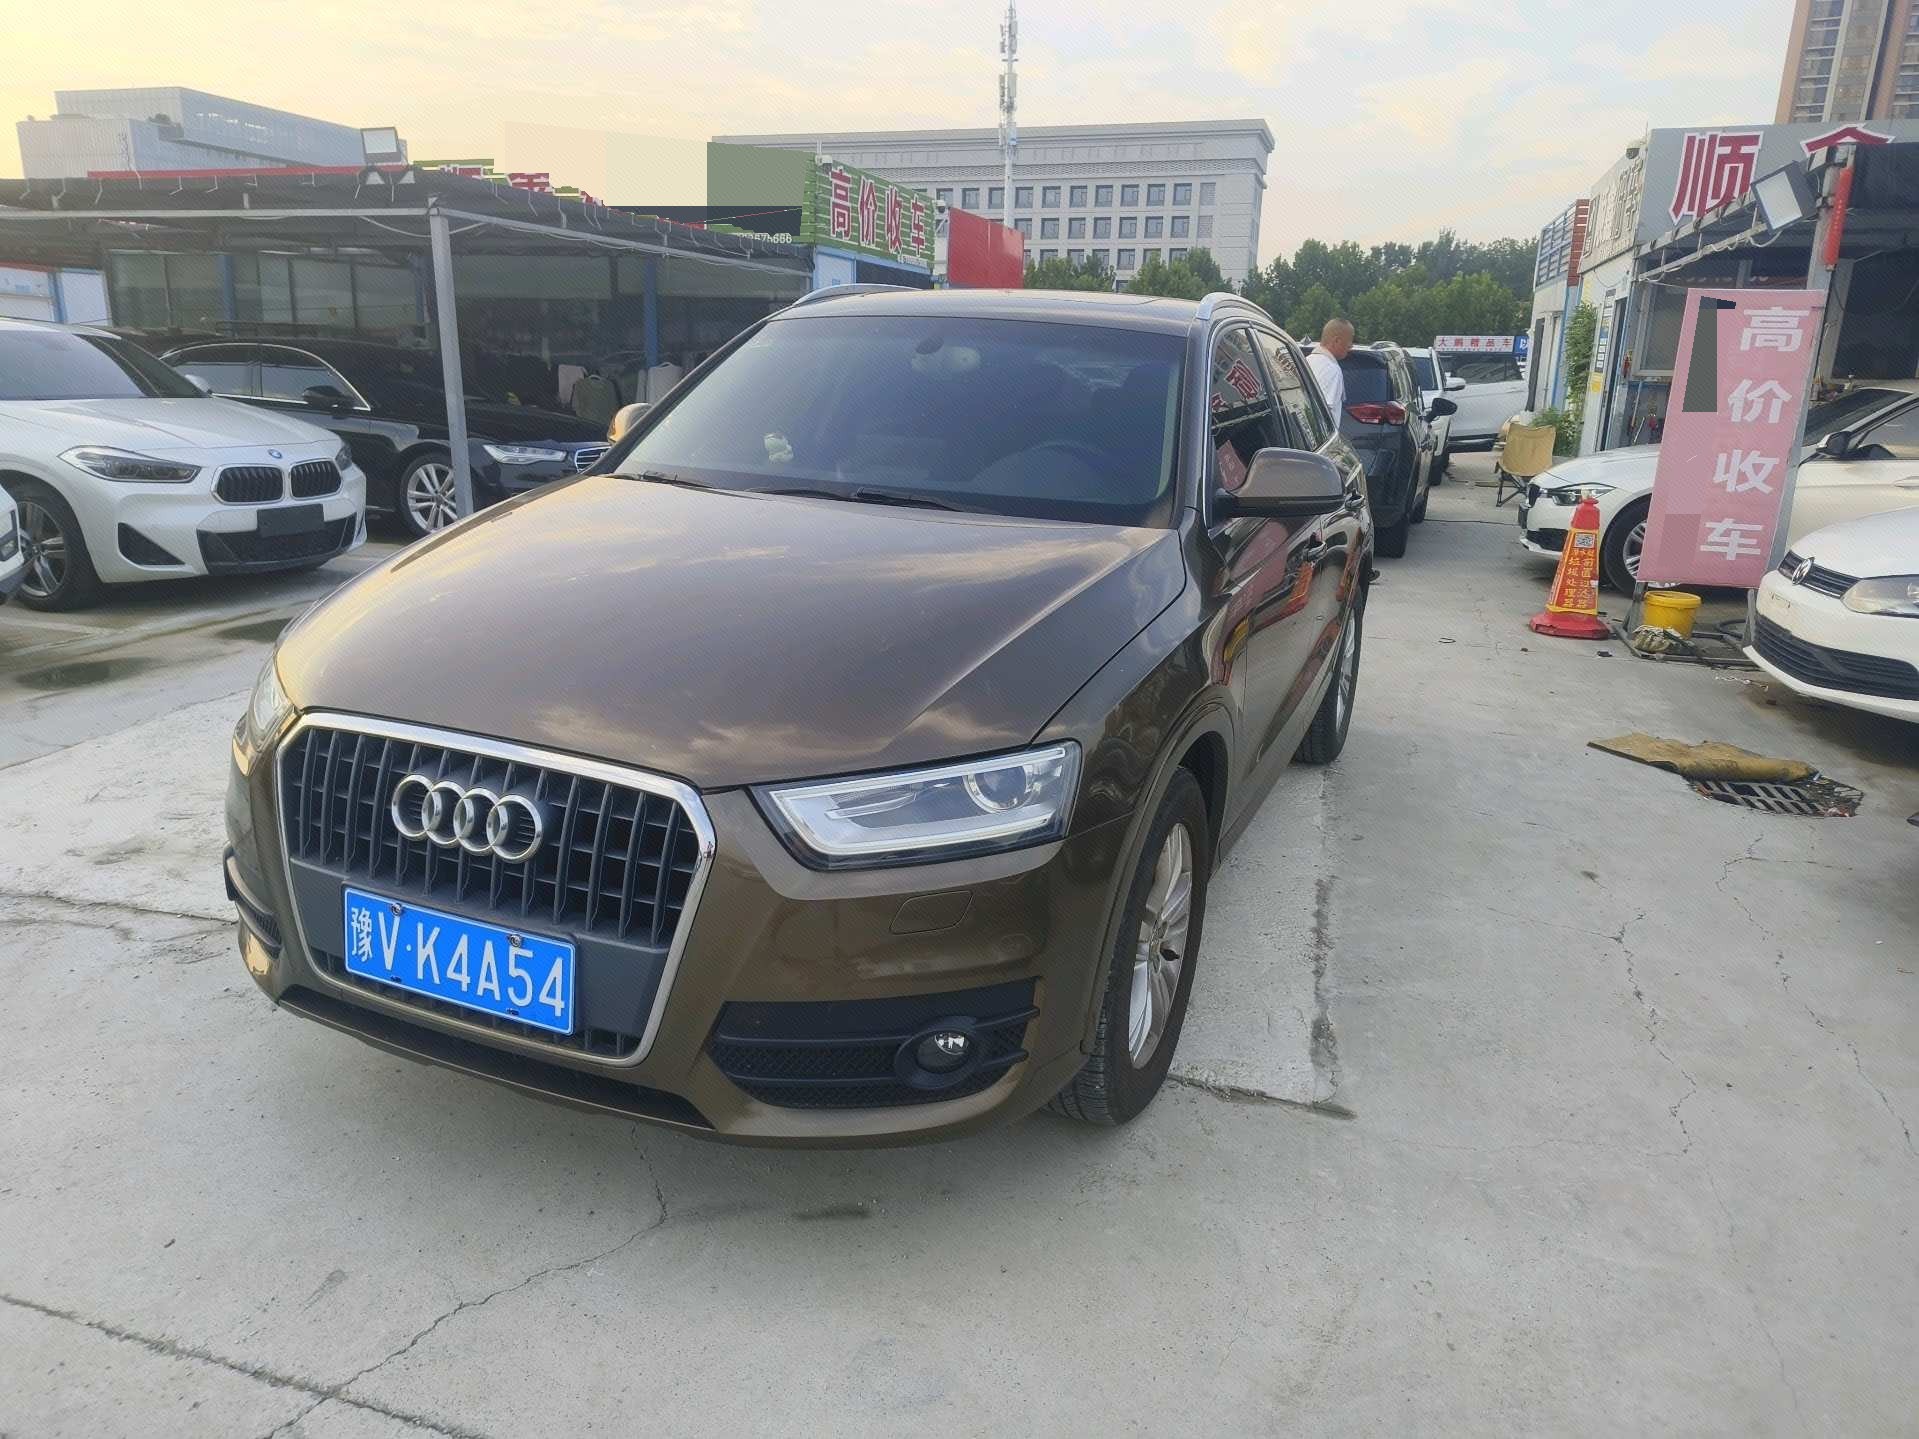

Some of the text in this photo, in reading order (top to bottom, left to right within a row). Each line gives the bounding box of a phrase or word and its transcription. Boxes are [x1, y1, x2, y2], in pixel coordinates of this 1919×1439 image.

[829, 166, 926, 257] 高价收车
[1700, 306, 1810, 560] 高价收车
[351, 907, 566, 1017] 豫V·K4A54
